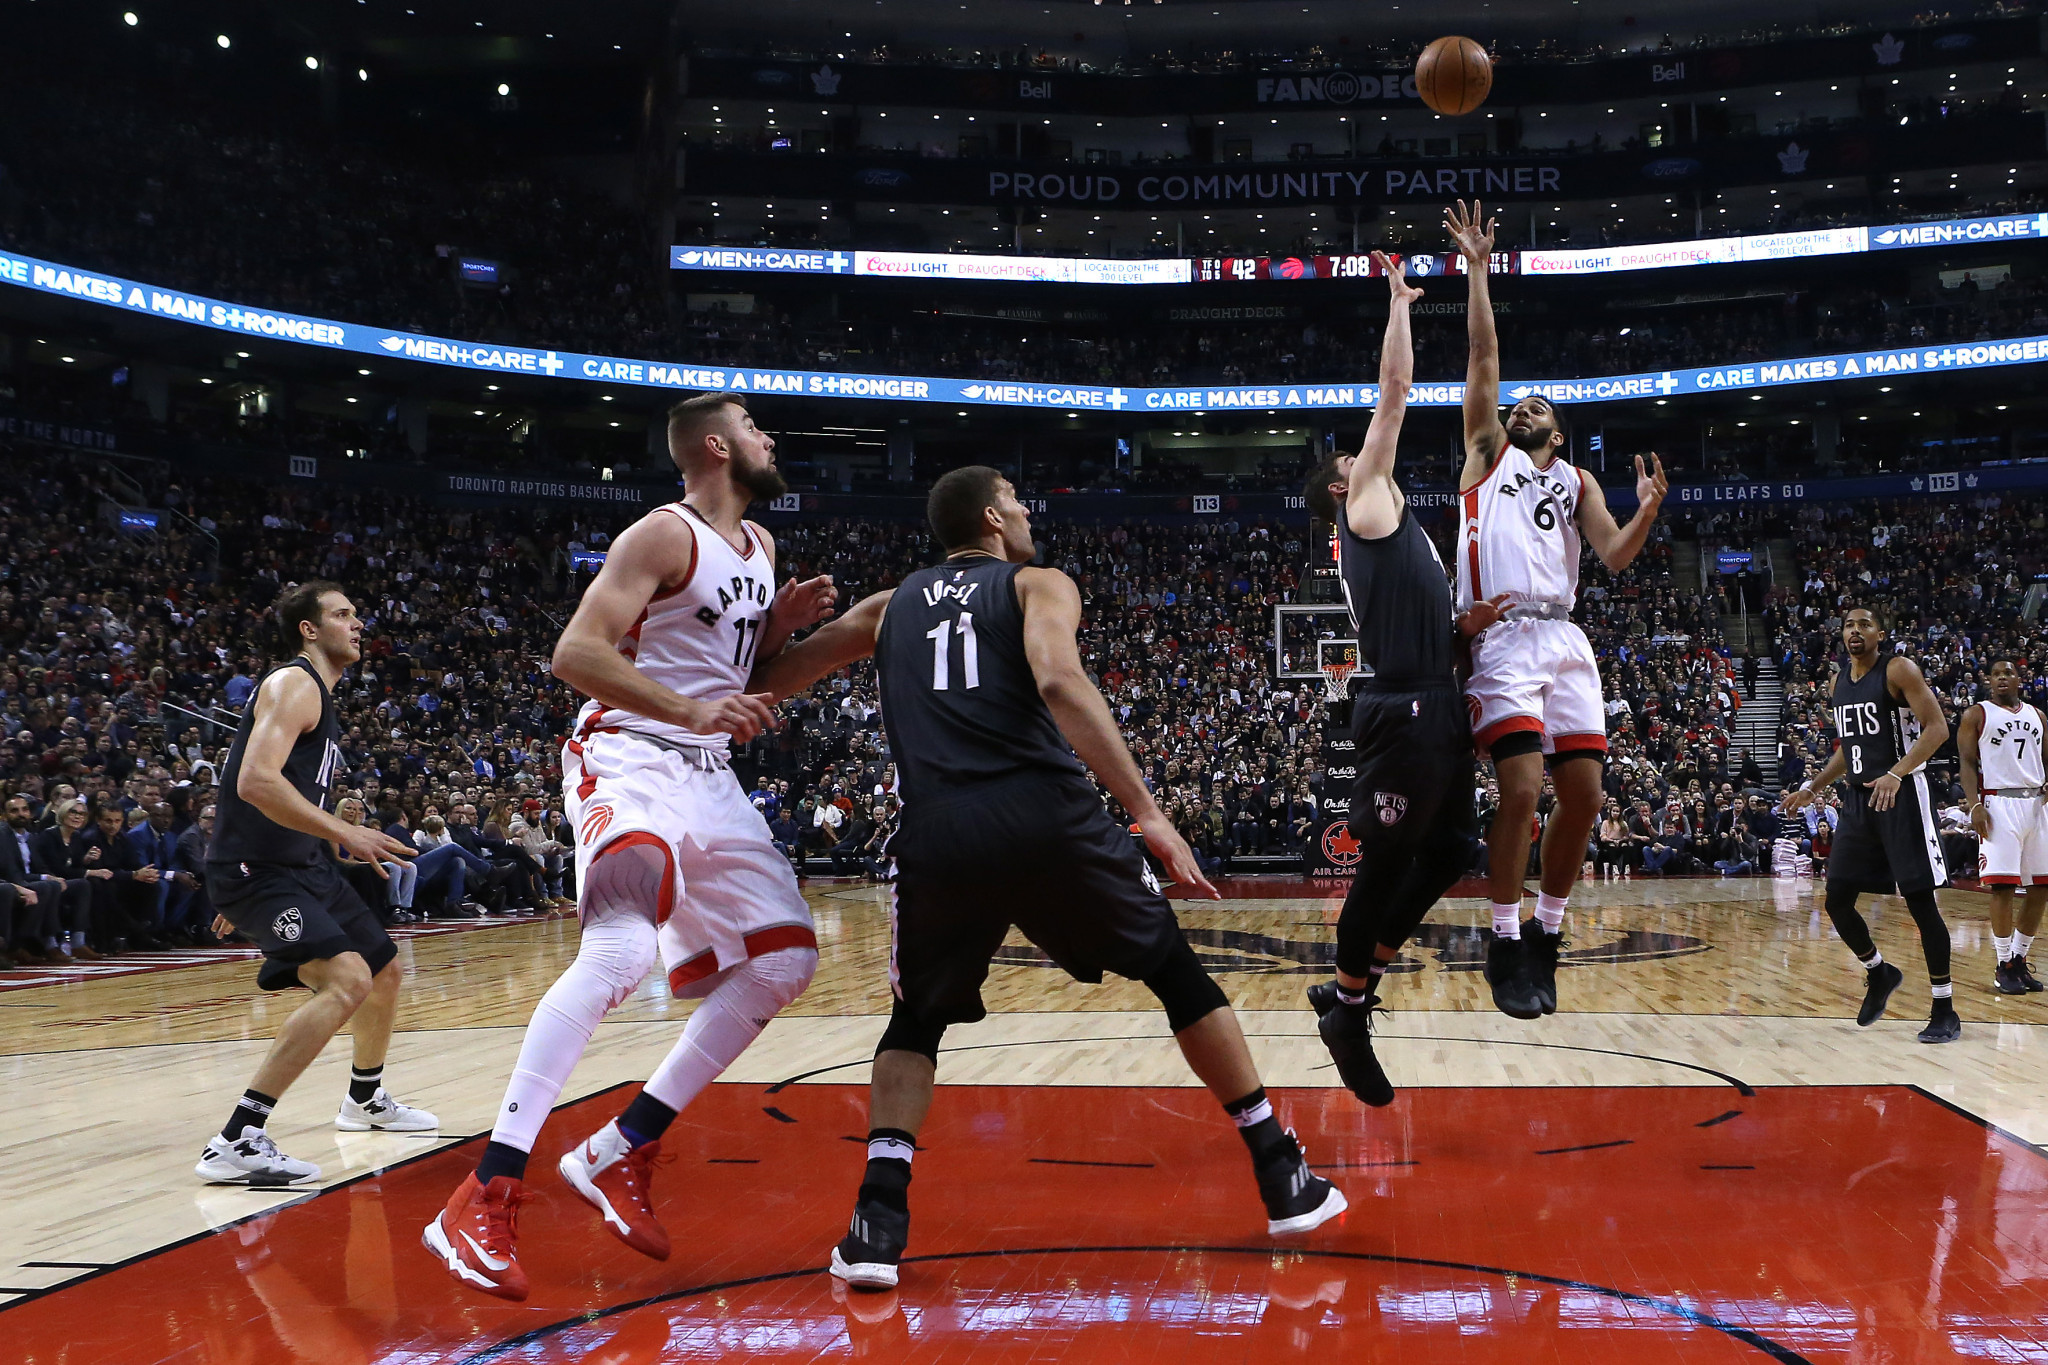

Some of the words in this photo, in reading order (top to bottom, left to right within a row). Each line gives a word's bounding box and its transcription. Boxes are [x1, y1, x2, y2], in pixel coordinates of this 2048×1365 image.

[1652, 62, 1685, 82] Bell
[1019, 80, 1051, 98] Bell
[1257, 78, 1325, 102] FAN
[1330, 80, 1352, 95] 600
[1360, 75, 1420, 99] DEC
[989, 171, 1120, 201] PROUD
[1138, 171, 1370, 201] COMMUNITY
[1386, 166, 1561, 195] PARTNER
[867, 256, 909, 273] Coors
[911, 262, 948, 273] LIGHT
[1202, 259, 1212, 270] TF
[1329, 256, 1370, 277] 7:08
[1455, 254, 1468, 275] 4
[1490, 253, 1500, 263] TF
[1530, 256, 1573, 271] Coors
[1575, 257, 1612, 269] LIGHT
[1622, 251, 1679, 266] DRAUGHT
[1681, 249, 1712, 261] DECK
[958, 264, 1014, 275] DRAUGHT
[1017, 266, 1047, 277] DECK
[1232, 258, 1256, 280] 42
[0, 256, 28, 282] RE
[33, 264, 123, 304] MAKES
[126, 287, 147, 309] A
[151, 292, 206, 322] MAN
[1169, 307, 1242, 319] DRAUGHT
[1246, 306, 1285, 318] DECK
[1409, 302, 1467, 314] RAUGHT
[583, 360, 643, 382] CARE
[649, 366, 725, 388] MAKES
[730, 372, 752, 389] A
[753, 373, 803, 392] MAN
[1696, 367, 1755, 389] CARE
[1760, 360, 1838, 383] MAKES
[1843, 358, 1860, 376] A
[1866, 353, 1917, 373] MAN
[1145, 392, 1202, 408] CARE
[1207, 390, 1280, 407] MAKES
[1285, 389, 1301, 405] A
[1306, 388, 1354, 405] MAN
[60, 425, 116, 449] NORTH
[293, 459, 314, 474] 111
[449, 476, 505, 493] TORONTO
[511, 480, 565, 497] RAPTORS
[570, 485, 642, 502] BASKETBALL
[1931, 474, 1955, 489] 115
[773, 496, 796, 508] 112
[1681, 488, 1702, 502] GO
[1714, 486, 1771, 501] LEAFS
[1783, 484, 1804, 498] GO
[1195, 497, 1219, 511] 113
[1534, 497, 1556, 531] 6
[695, 576, 767, 627] RAPTO
[733, 617, 760, 667] 17
[926, 611, 980, 691] 11
[1834, 702, 1880, 738] NETS
[2014, 739, 2026, 759] 7
[1852, 745, 1863, 774] 8
[1376, 794, 1406, 810] NETS
[1313, 868, 1332, 876] AIR
[1334, 868, 1357, 876] CAN
[272, 909, 300, 935] NETS
